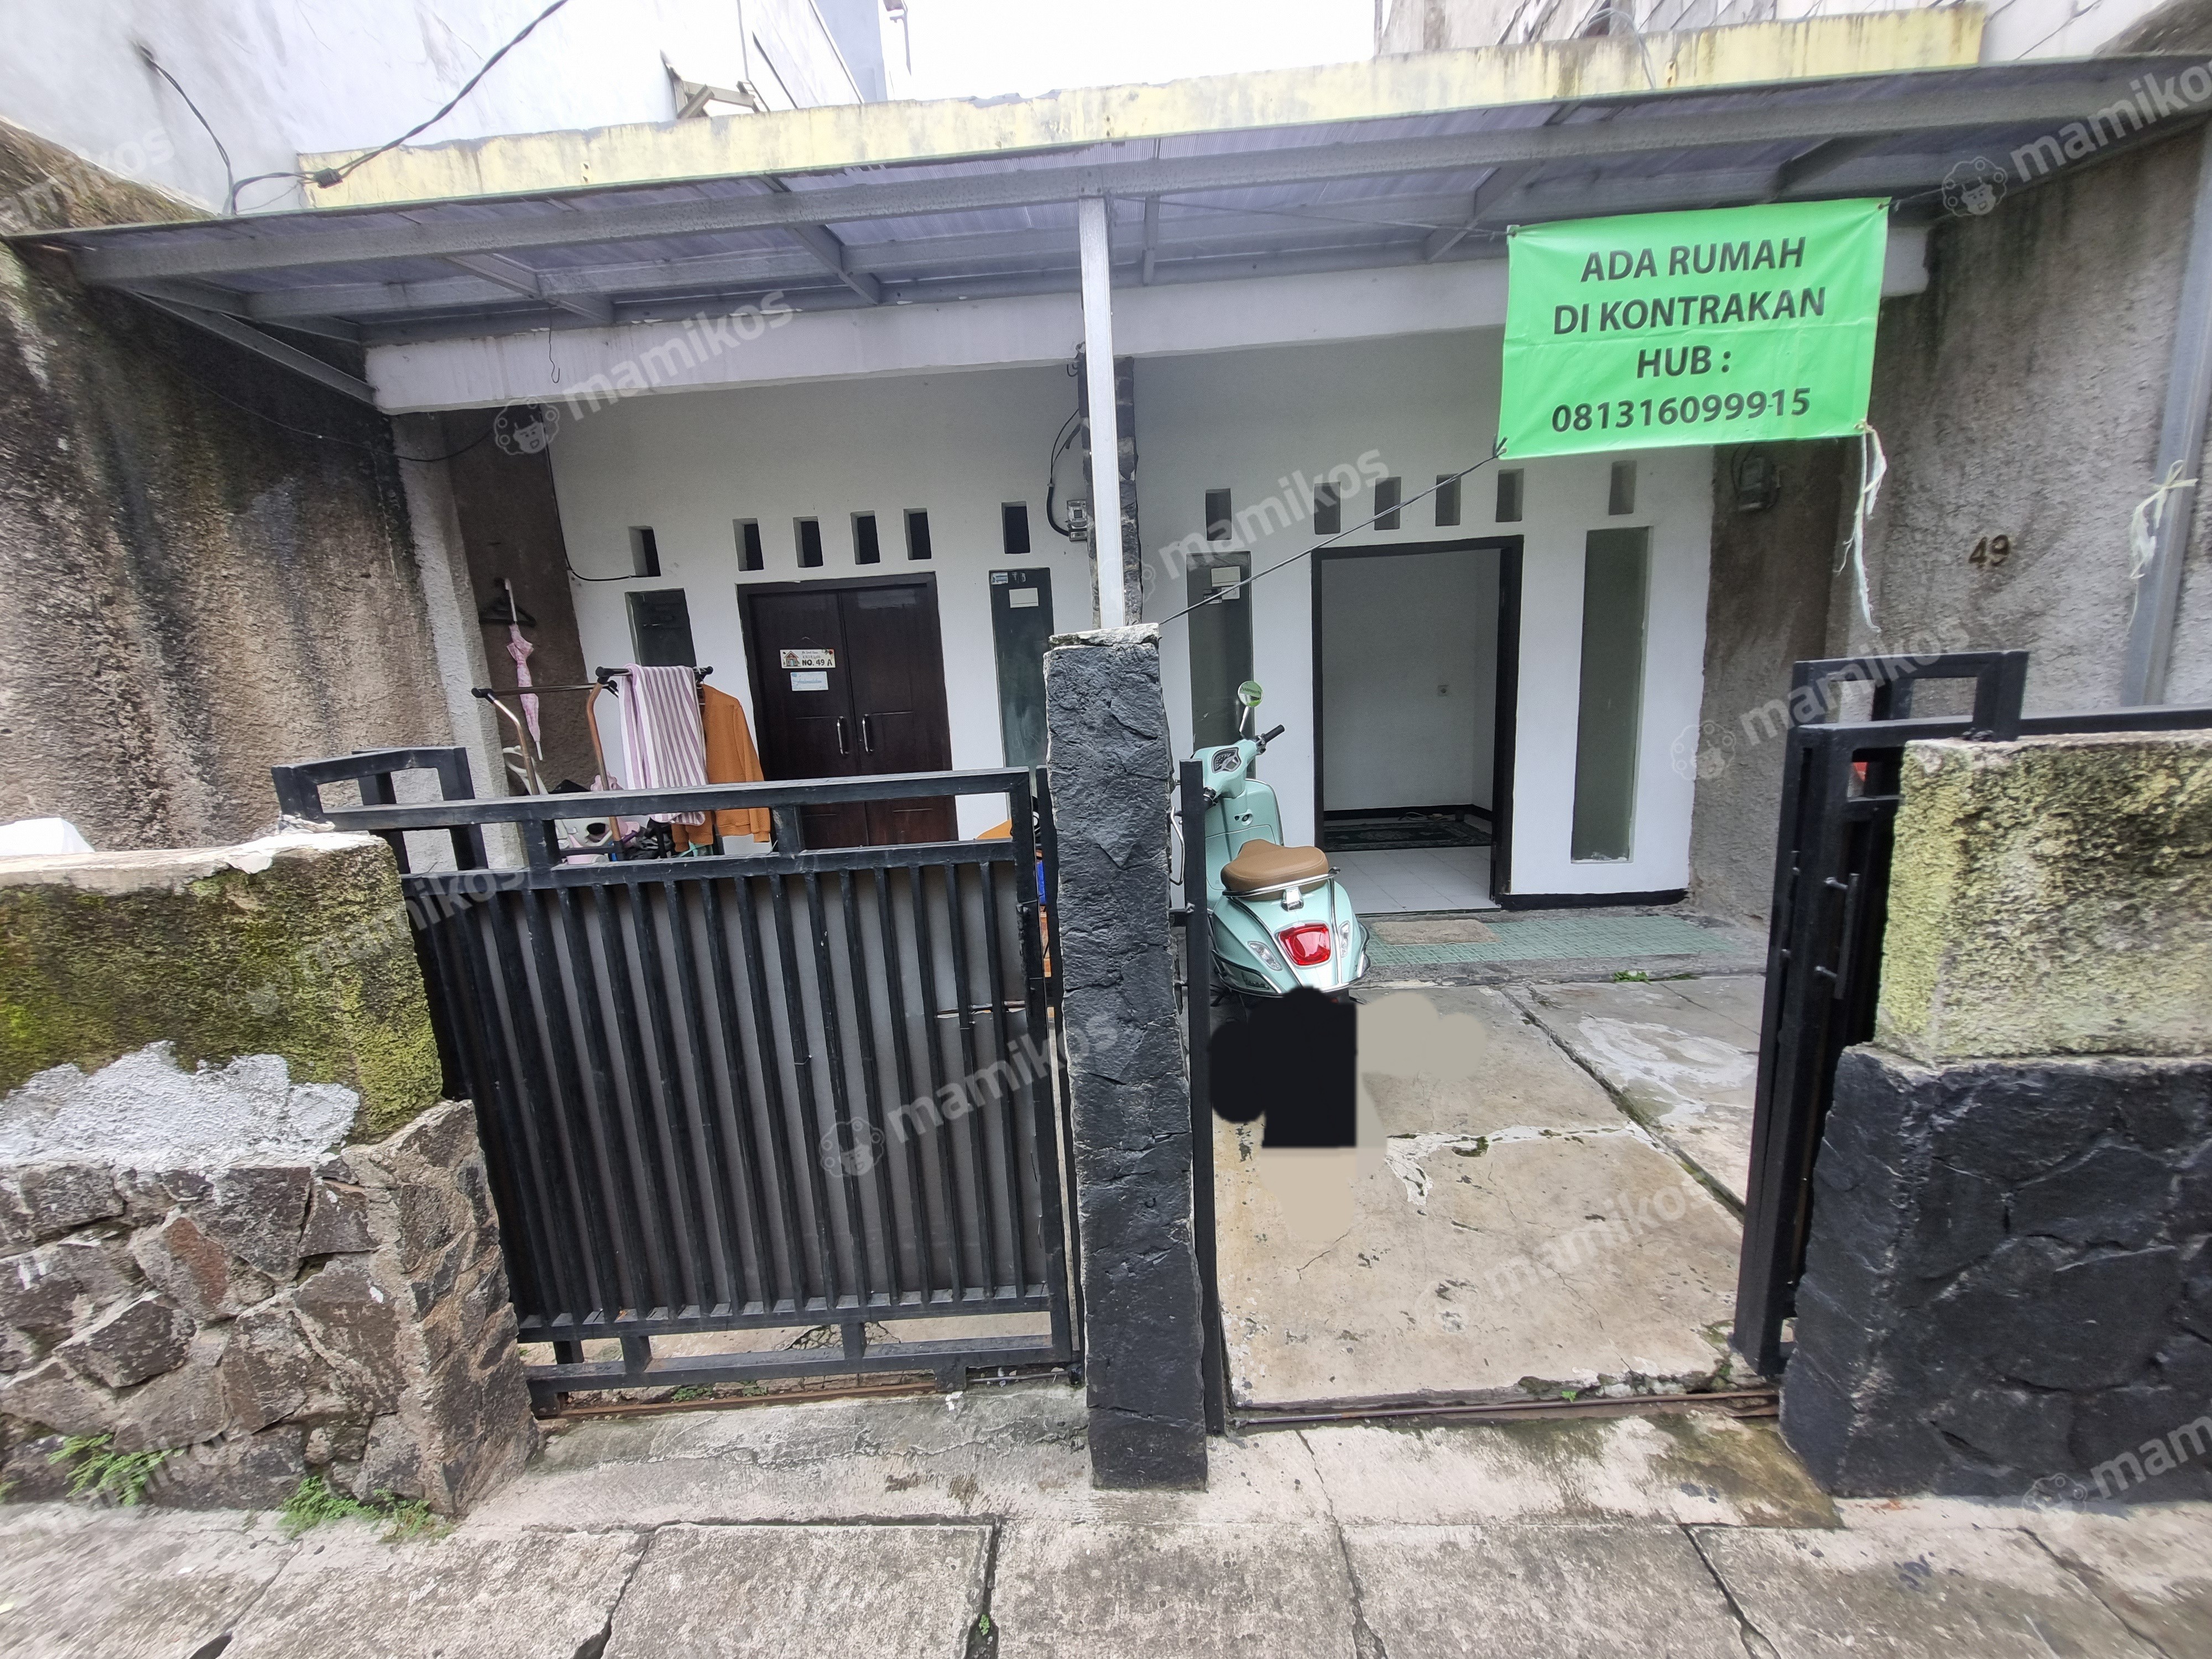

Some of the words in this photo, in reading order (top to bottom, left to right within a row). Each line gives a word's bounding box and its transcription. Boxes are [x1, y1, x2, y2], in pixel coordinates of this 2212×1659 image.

[1580, 247, 1658, 283] ADA
[1668, 236, 1806, 276] RUMAH
[1553, 302, 1590, 336] DI
[1599, 286, 1826, 332] KONTRAKAN
[1636, 345, 1712, 379] HUB
[1720, 350, 1731, 374] :
[1969, 534, 2010, 568] 49
